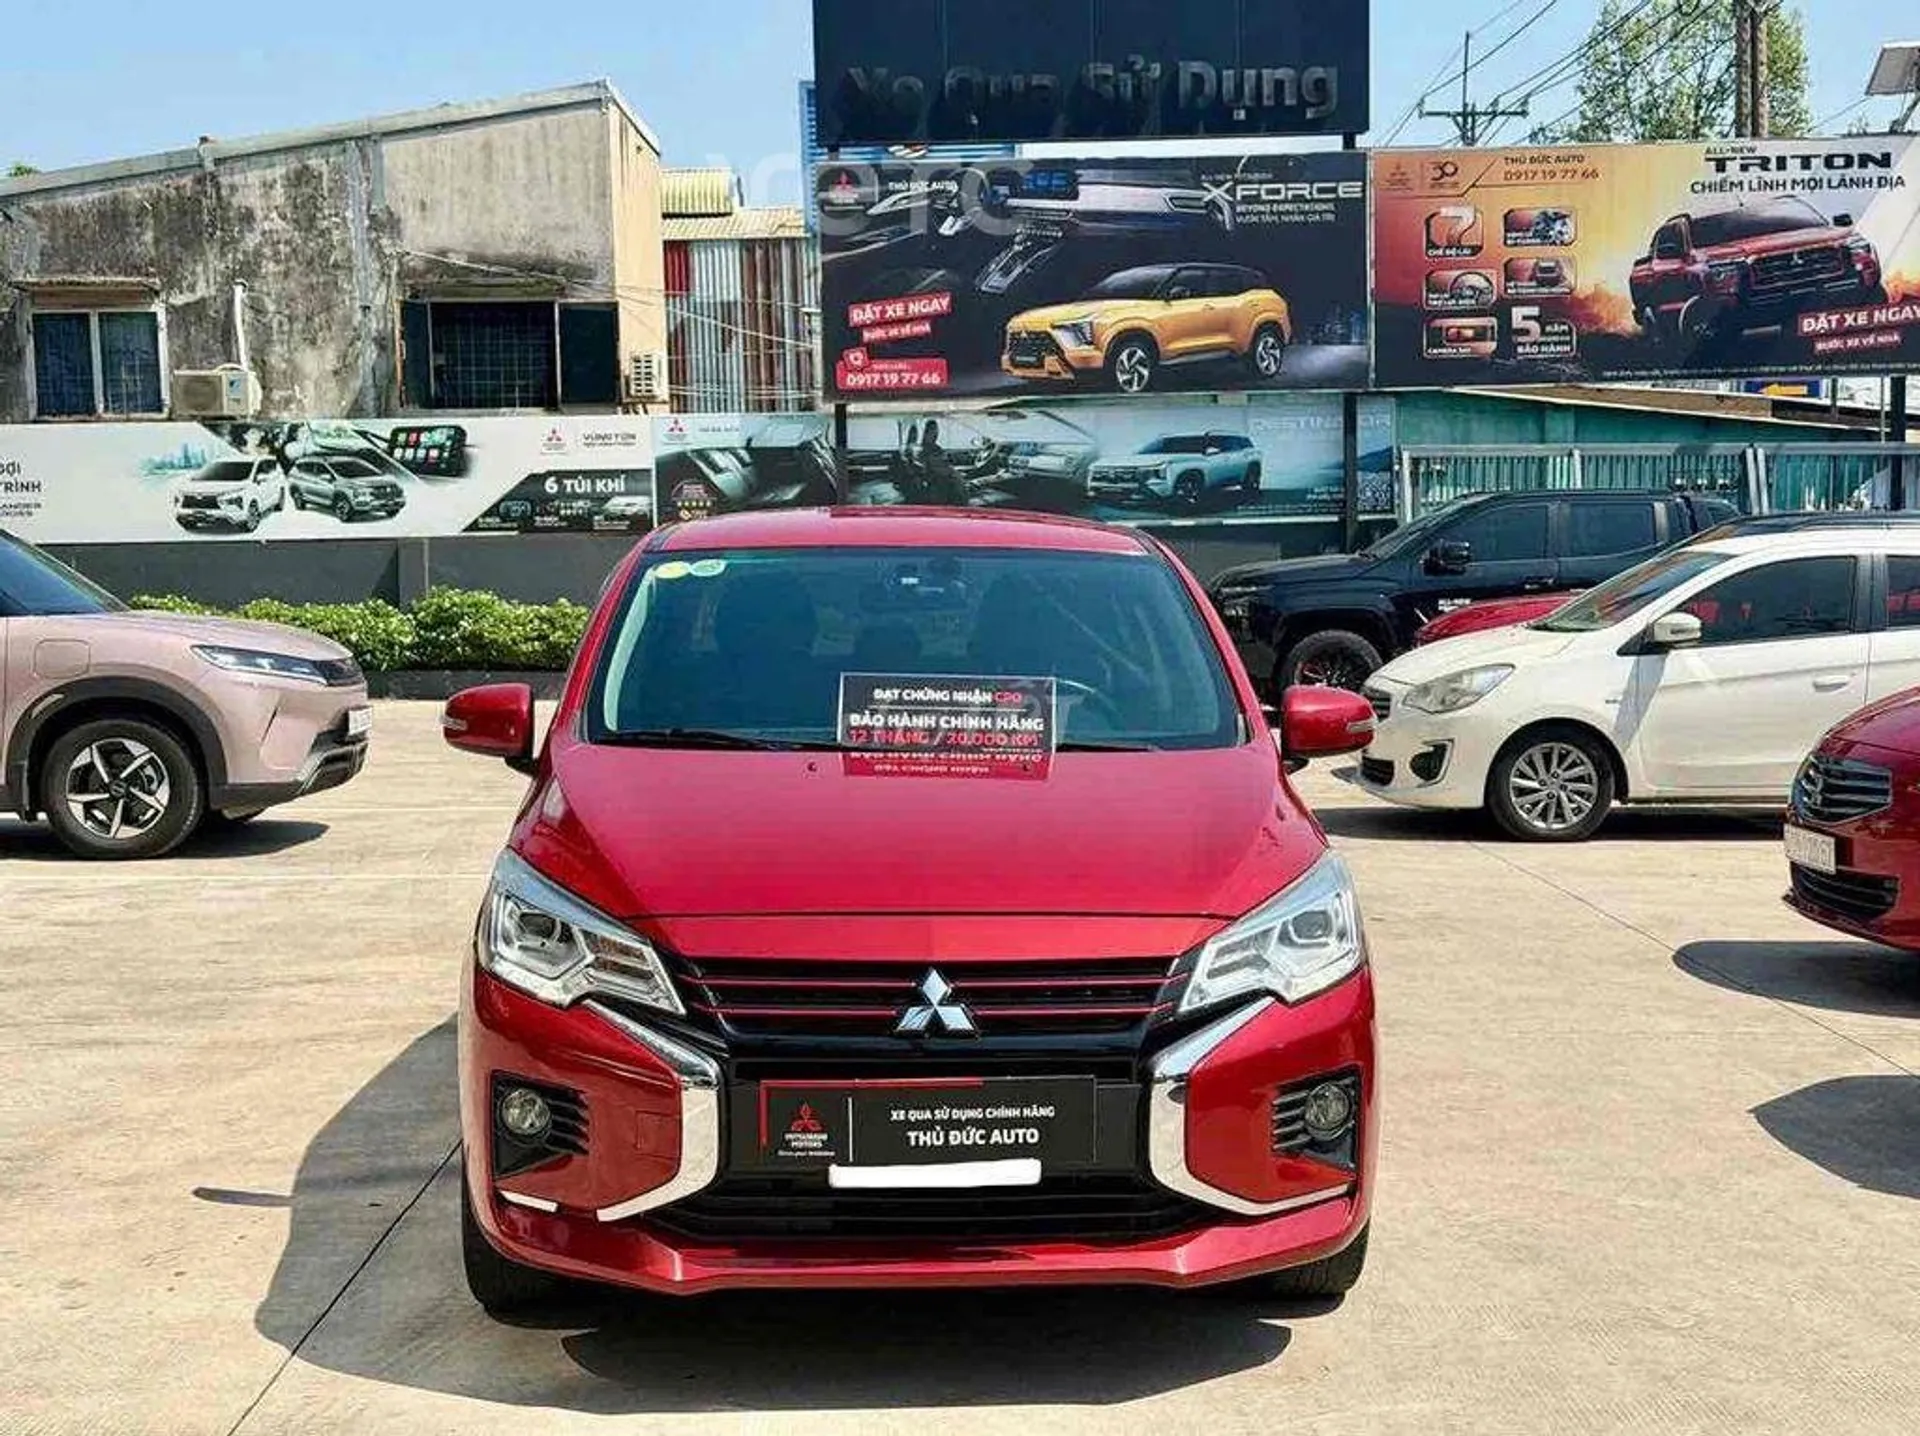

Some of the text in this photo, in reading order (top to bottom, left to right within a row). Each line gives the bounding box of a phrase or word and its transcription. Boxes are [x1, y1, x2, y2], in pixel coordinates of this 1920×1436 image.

[1177, 60, 1338, 121] Dụng
[1554, 154, 1585, 164] AUTO
[1704, 152, 1893, 173] TRITON
[1503, 167, 1600, 181] 0917 19 77 66
[1691, 175, 1906, 194] CHIẾM LĨNH MỌI LÃNH ĐỊA
[1202, 181, 1363, 202] XFORCE
[885, 303, 905, 318] XE
[908, 297, 951, 314] NGAY
[1511, 306, 1541, 342] 5
[1802, 305, 1920, 334] ĐẶT XE NGAY
[847, 372, 941, 386] 0917 19 77 66
[544, 473, 626, 494] 6 TÚI KHÍ
[849, 711, 1044, 731] BẢO HÀNH CHÍNH HÃNG
[850, 729, 869, 744] 12
[871, 728, 929, 744] THÁNG
[890, 1104, 1056, 1122] XE QUA SỬ DỤNG CHÍNH HÃNG
[907, 1125, 1040, 1146] THỦ ĐỨC AUTO
